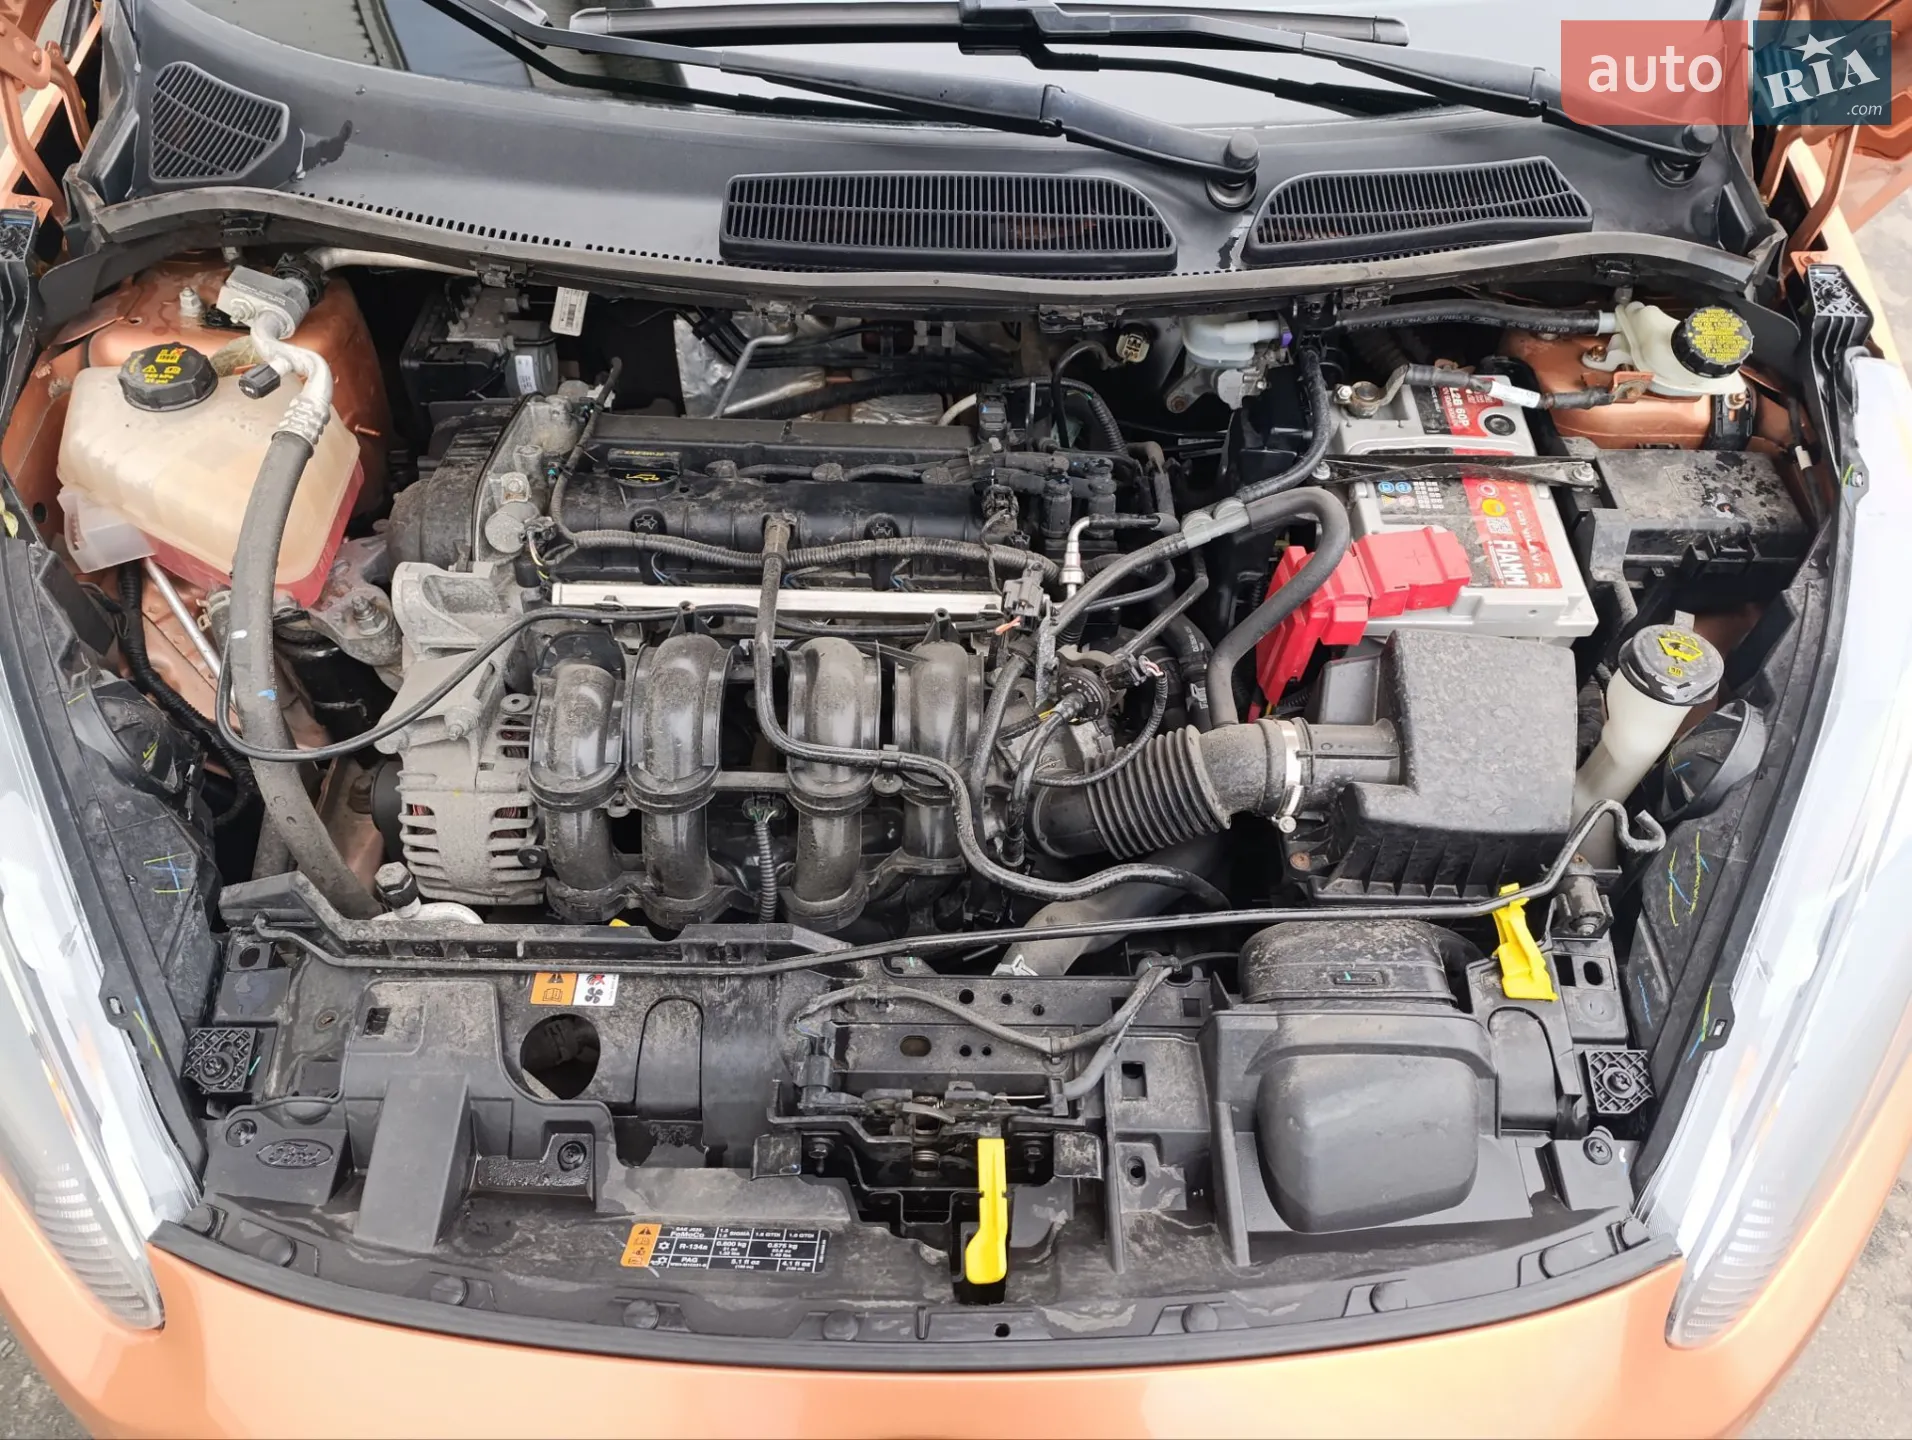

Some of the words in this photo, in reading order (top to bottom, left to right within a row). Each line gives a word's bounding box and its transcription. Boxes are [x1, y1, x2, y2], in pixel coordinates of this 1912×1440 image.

[1455, 408, 1470, 427] 60P
[1493, 540, 1530, 586] FIAMM
[268, 1142, 320, 1165] Ford
[679, 1243, 709, 1251] R-134a
